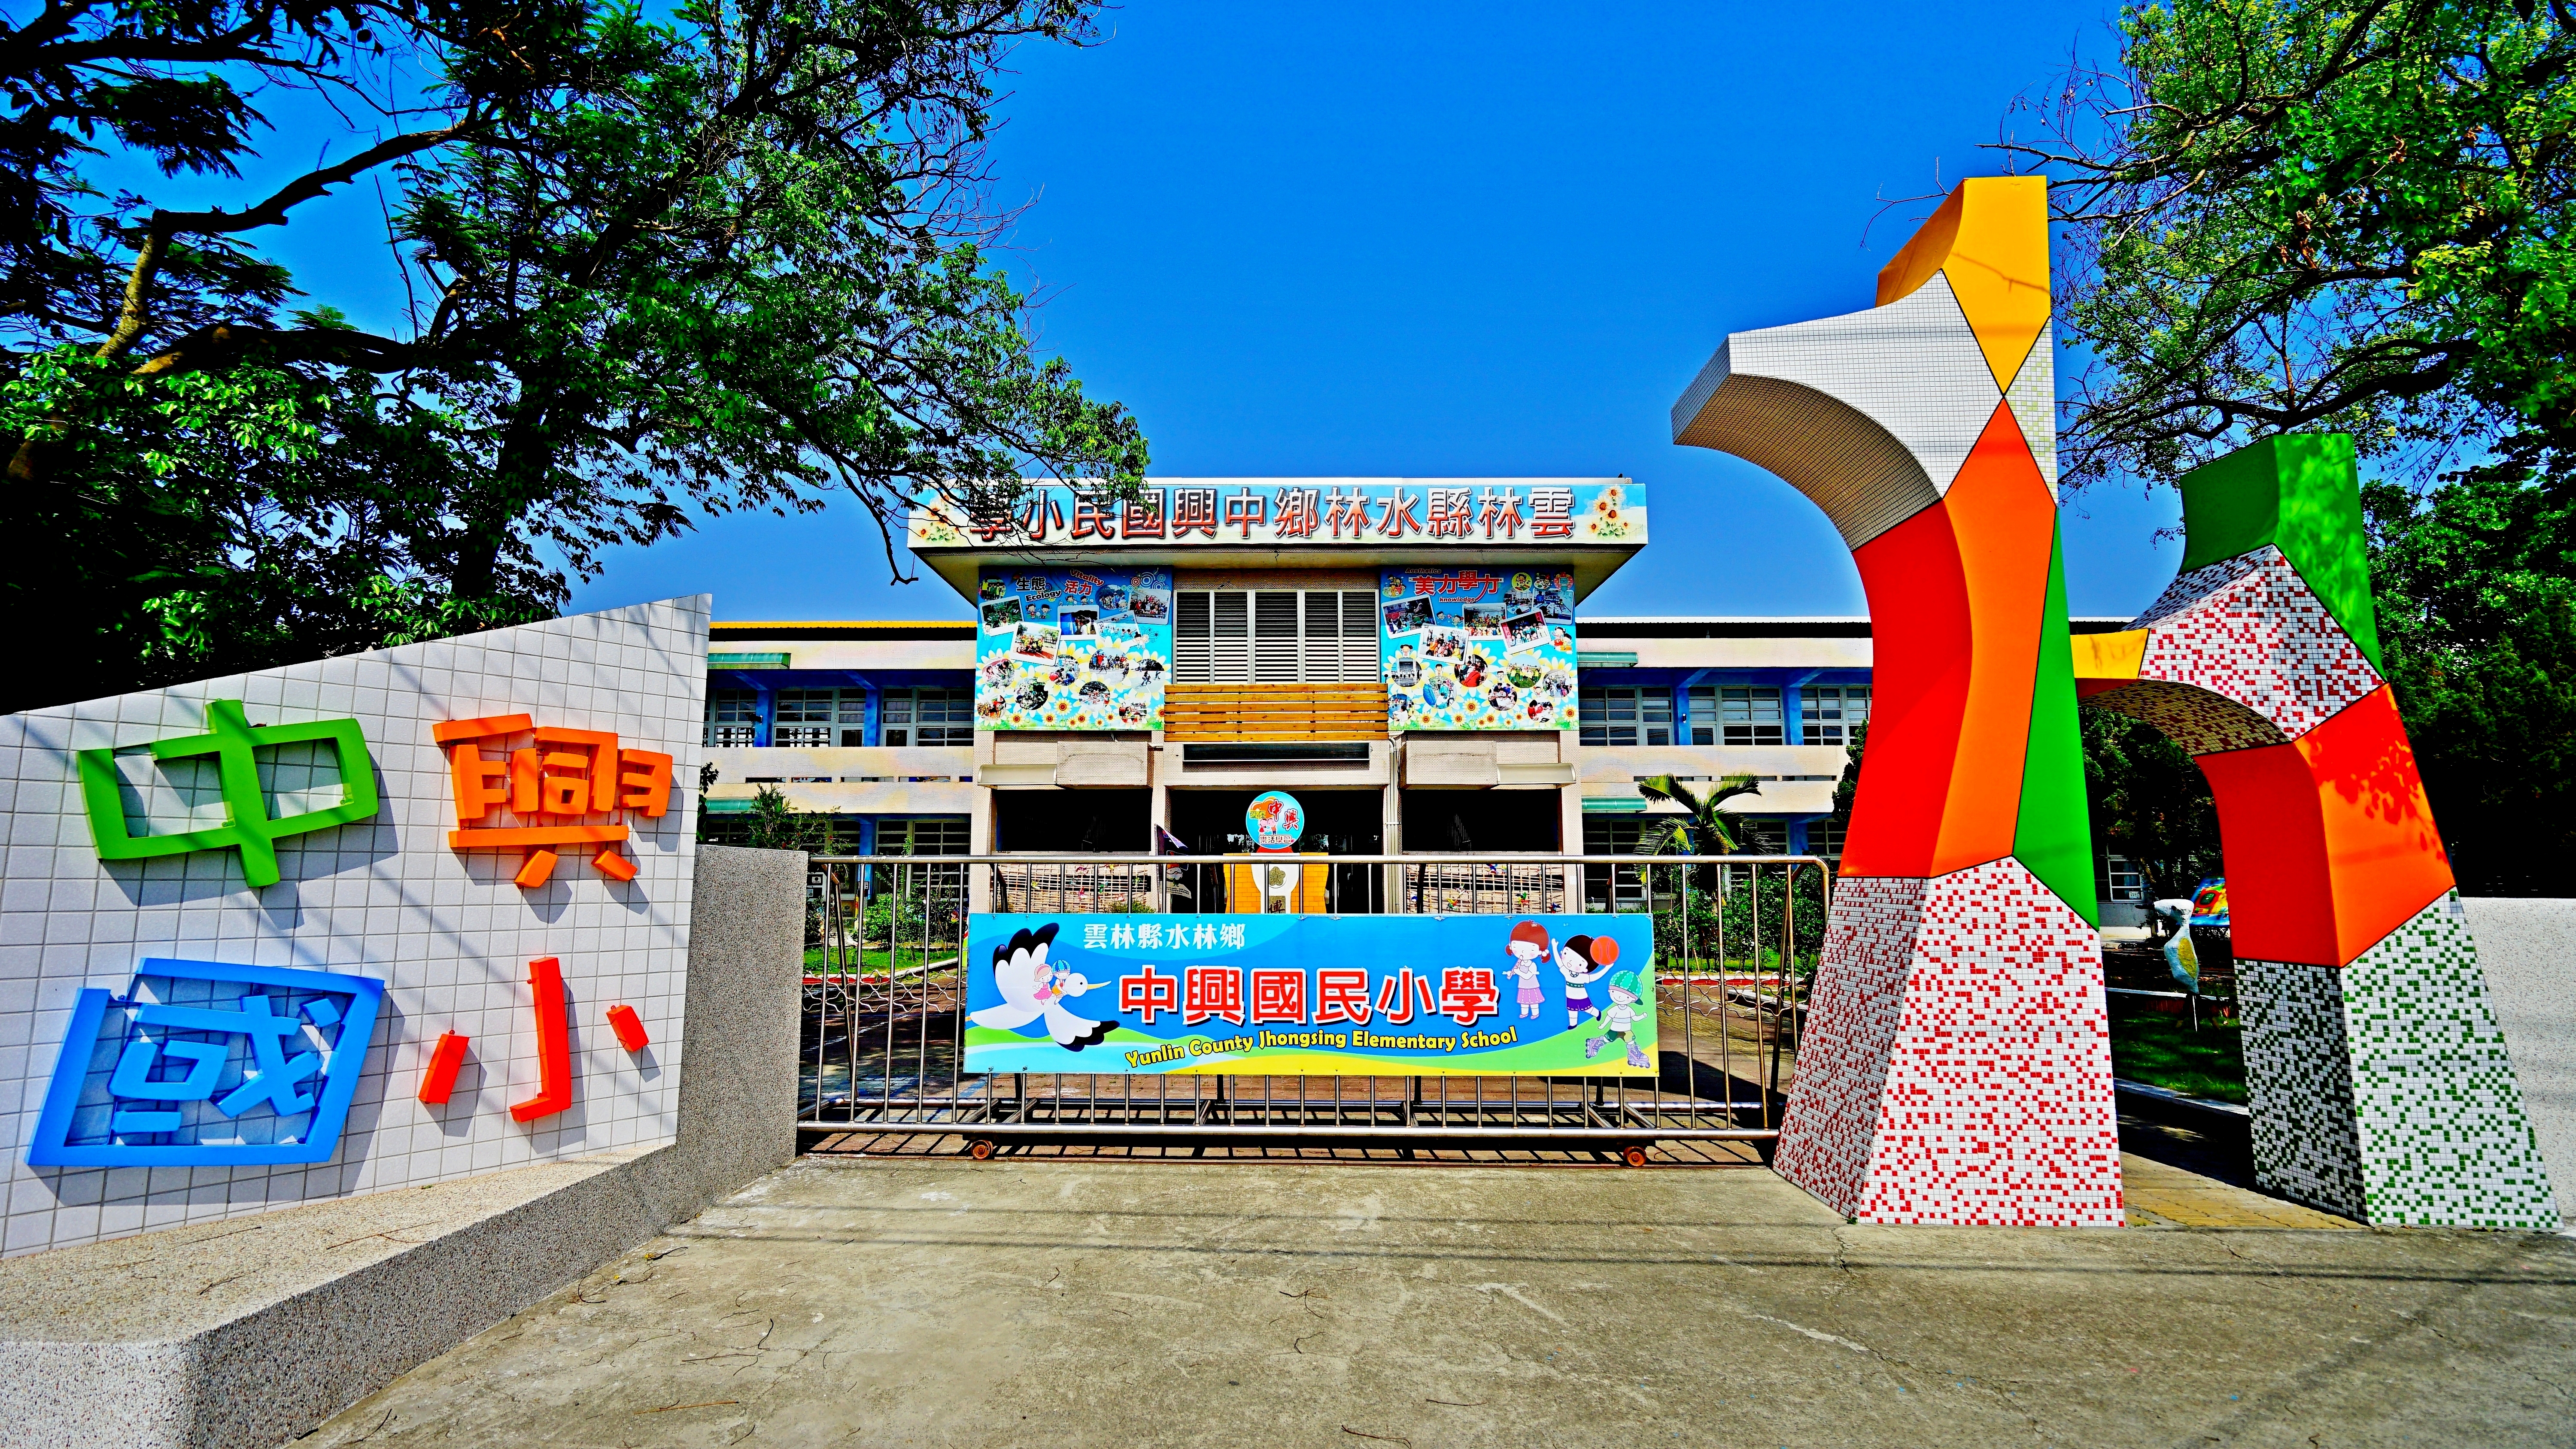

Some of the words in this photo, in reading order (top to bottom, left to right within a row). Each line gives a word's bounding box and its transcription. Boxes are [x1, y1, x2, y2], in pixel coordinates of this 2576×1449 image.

[1015, 576, 1046, 592] 生態
[1064, 579, 1093, 596] 活力
[1070, 569, 1104, 587] Vitality
[1409, 570, 1503, 599] 美力學力
[1025, 590, 1062, 602] Ecology
[76, 699, 673, 888] 中興
[1268, 799, 1300, 831] 中興
[1260, 835, 1291, 844] 樂活學習
[1083, 923, 1246, 949] 雲林縣水林鄉
[1118, 964, 1500, 1027] 中興國民小學
[1125, 1044, 1185, 1068] Yunlin
[1189, 1034, 1254, 1057] County
[1258, 1029, 1346, 1050] Jhongsing
[1352, 1030, 1456, 1052] Elementary
[1461, 1025, 1518, 1049] School
[24, 956, 650, 1167] 國小
